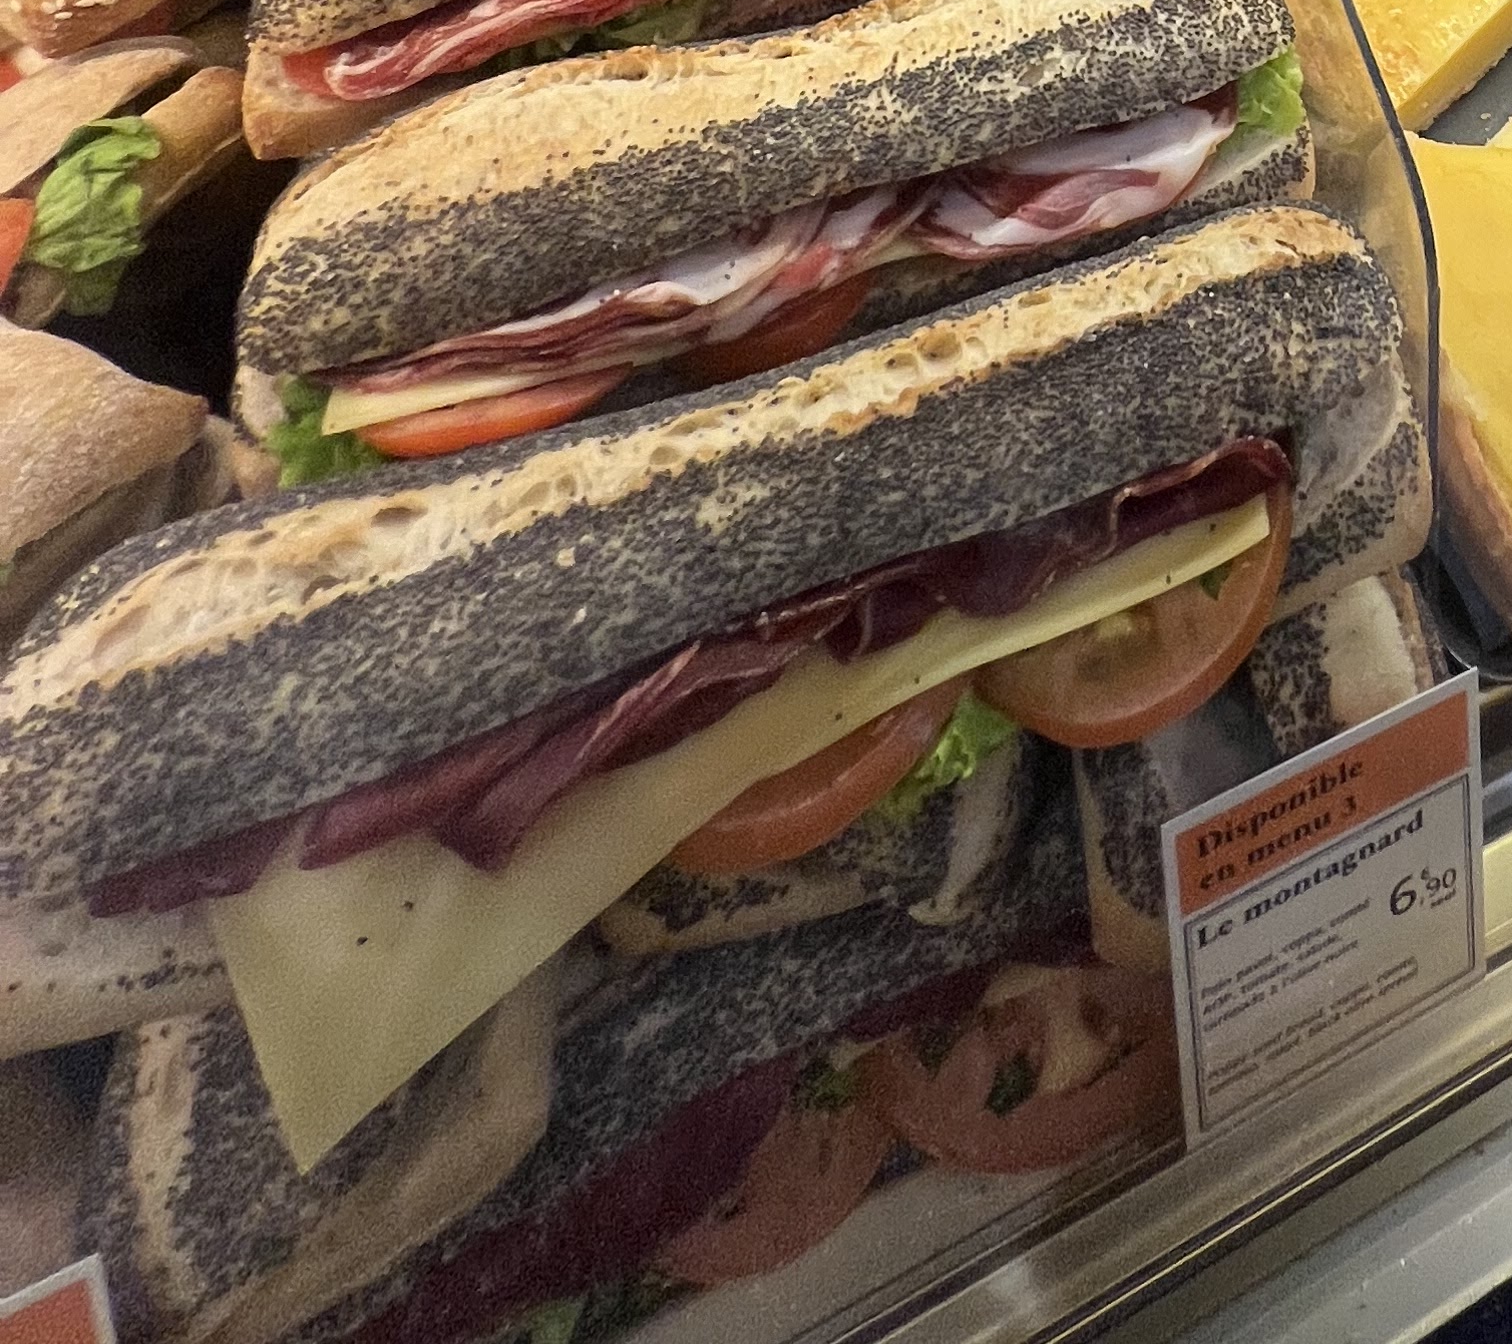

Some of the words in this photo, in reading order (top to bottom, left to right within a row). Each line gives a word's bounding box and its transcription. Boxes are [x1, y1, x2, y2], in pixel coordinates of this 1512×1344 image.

[1197, 758, 1363, 859] Disponible
[1199, 858, 1236, 892] en
[1246, 811, 1332, 870] menu
[1342, 797, 1358, 823] 3
[1197, 916, 1233, 951] Le
[1242, 809, 1424, 925] montagnard
